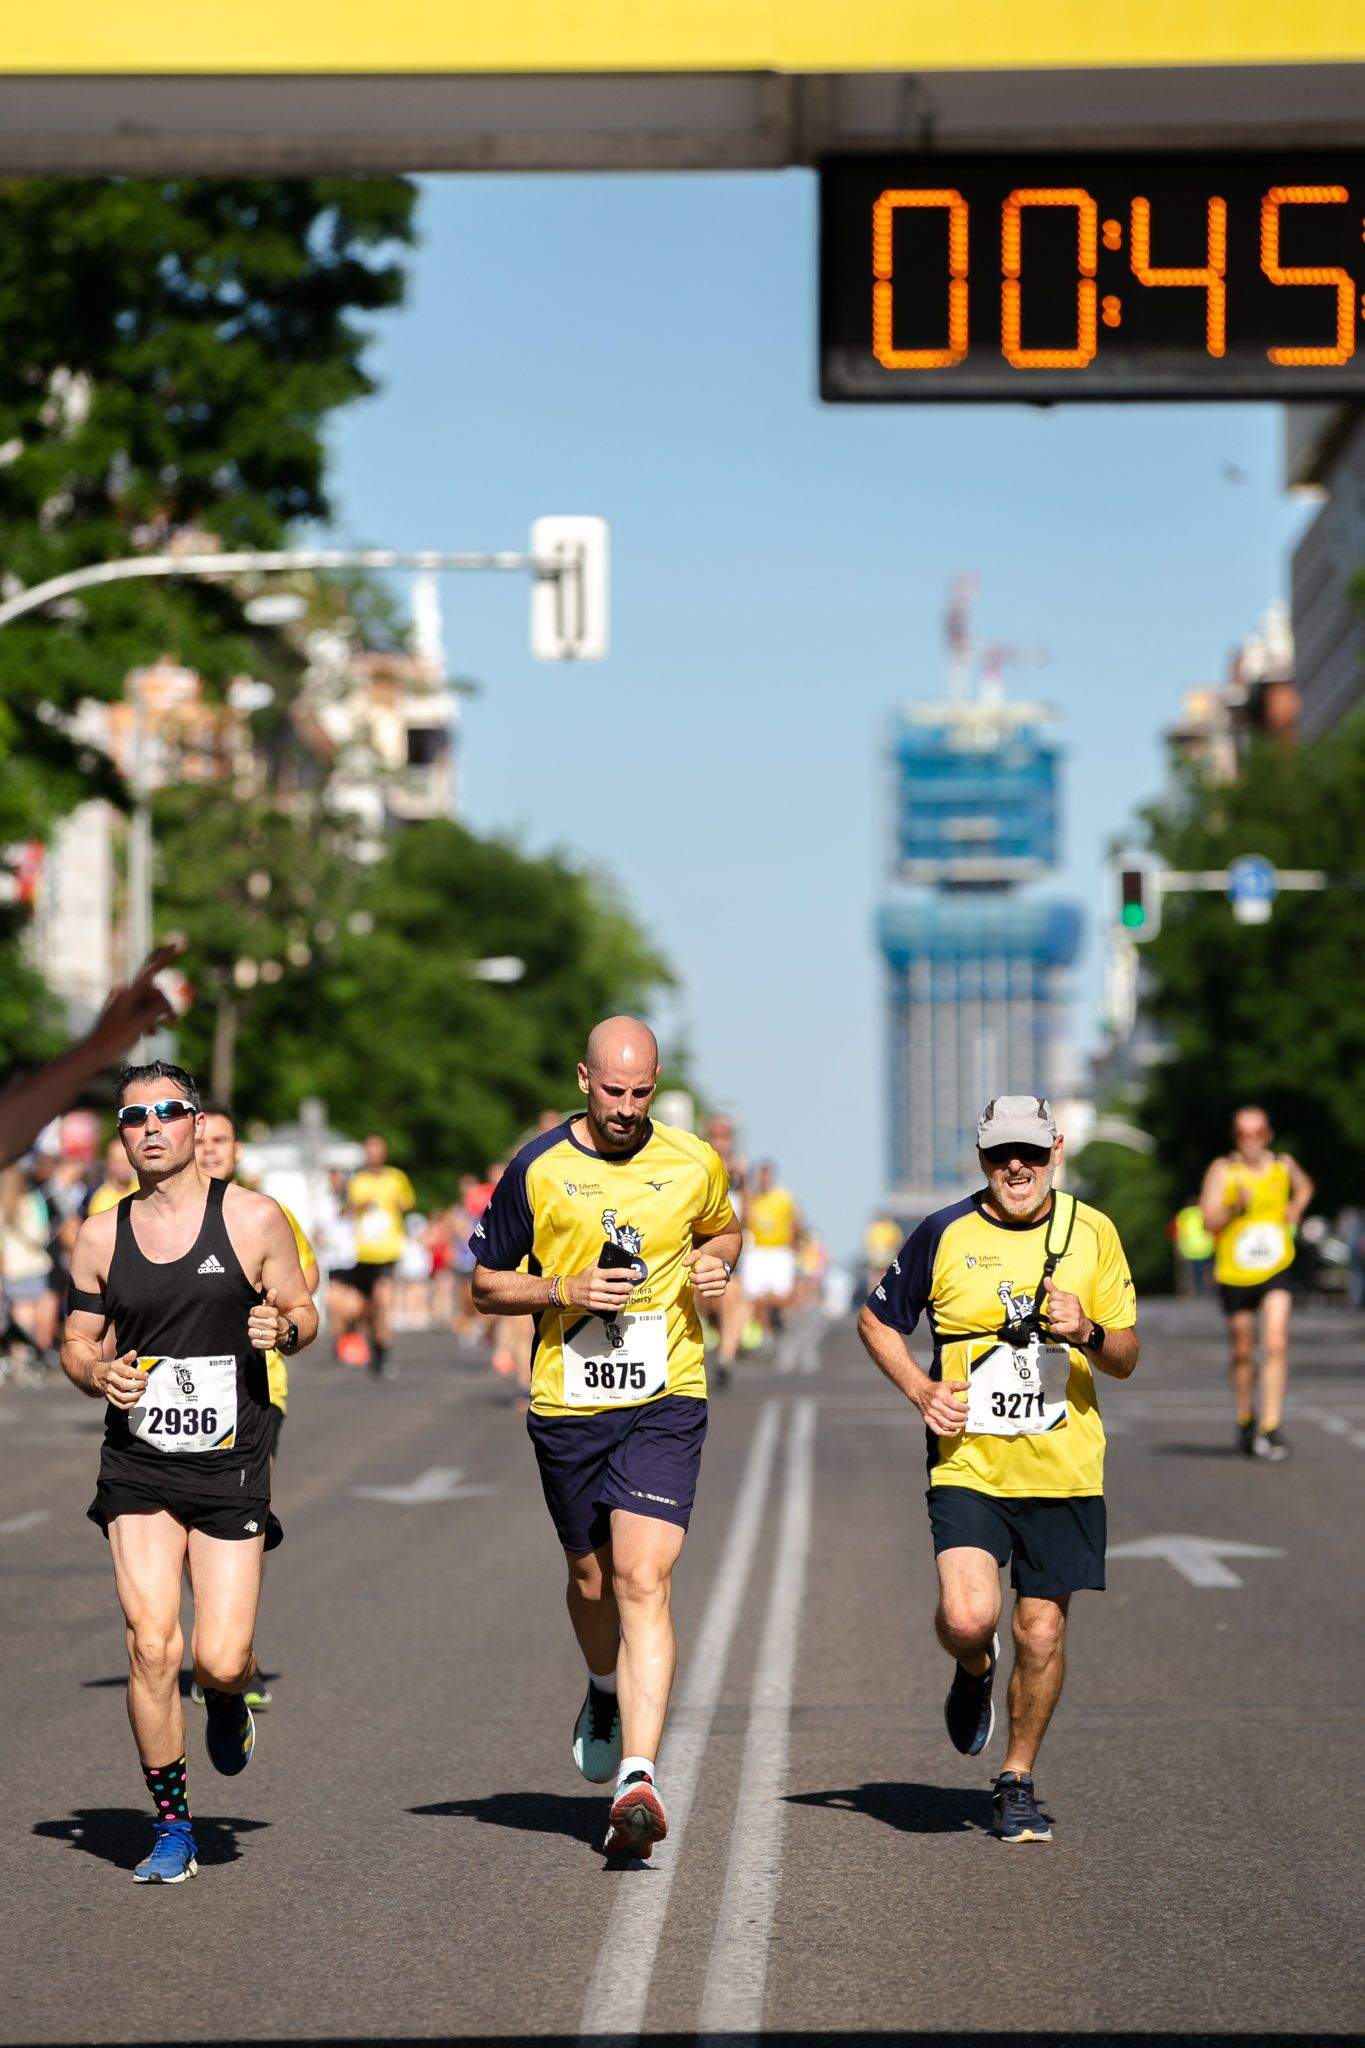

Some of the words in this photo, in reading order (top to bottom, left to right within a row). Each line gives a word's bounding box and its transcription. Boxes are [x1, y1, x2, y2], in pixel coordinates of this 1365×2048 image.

[872, 185, 1365, 369] 00:45
[198, 1263, 225, 1274] adidas
[584, 1361, 646, 1390] 3875
[991, 1391, 1046, 1419] 3271
[148, 1406, 218, 1436] 2936
